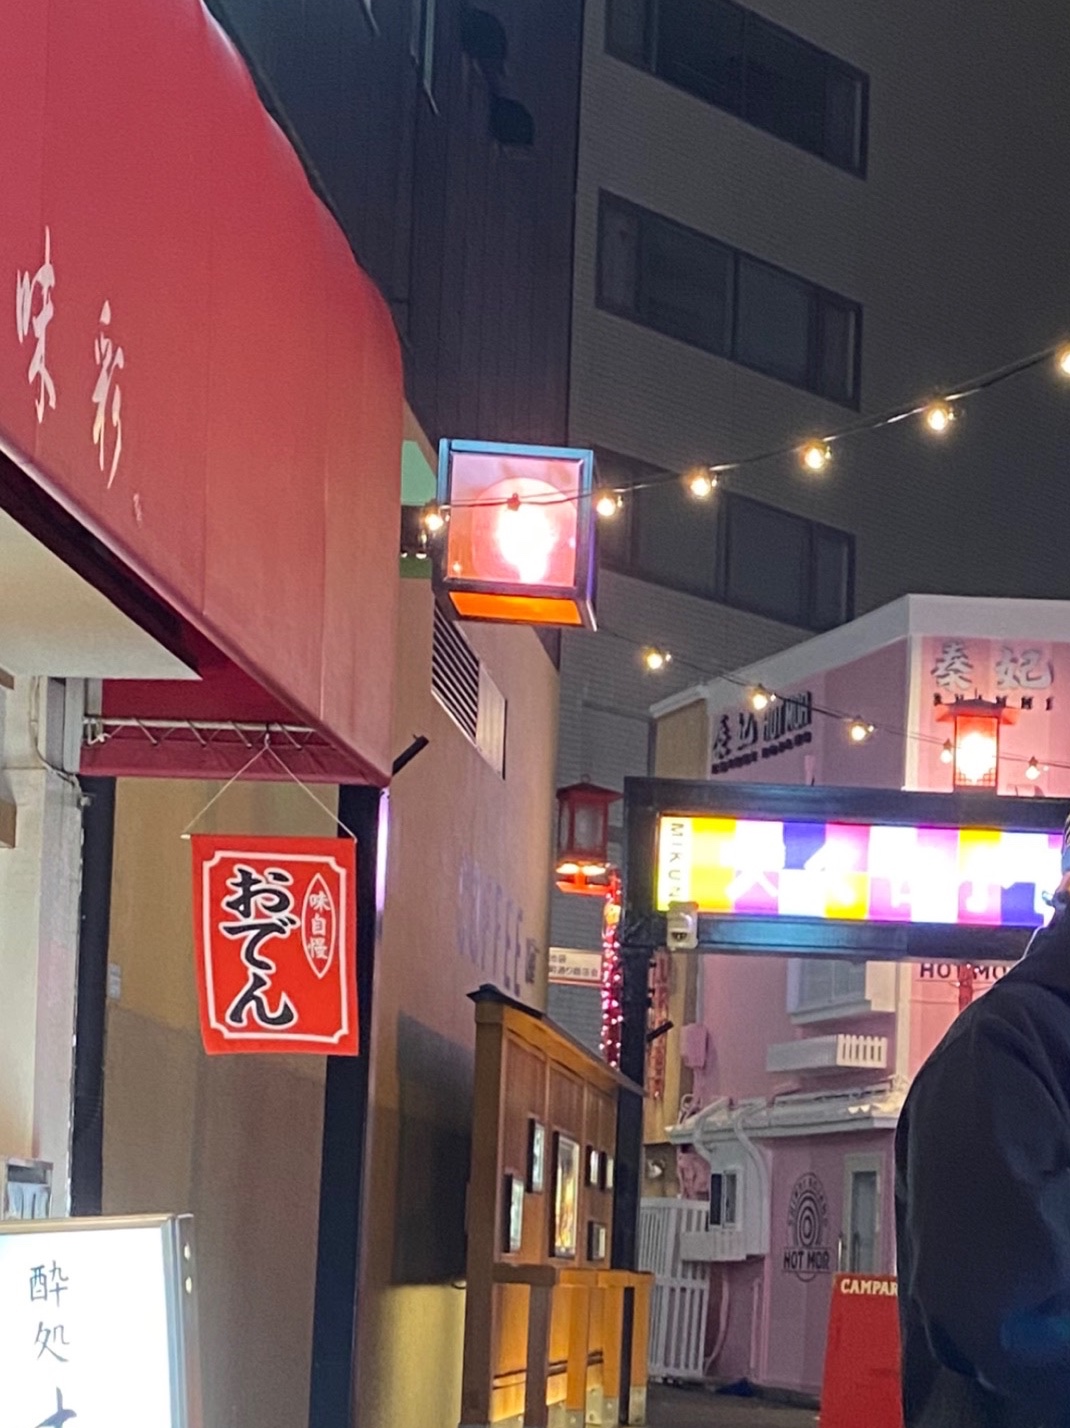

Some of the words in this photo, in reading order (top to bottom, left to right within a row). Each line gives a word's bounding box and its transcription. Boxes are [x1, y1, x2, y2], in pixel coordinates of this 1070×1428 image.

[219, 864, 301, 1030] おでん
[308, 891, 332, 960] 味自慢
[784, 1251, 804, 1270] HOT
[29, 1259, 70, 1362] 酔処
